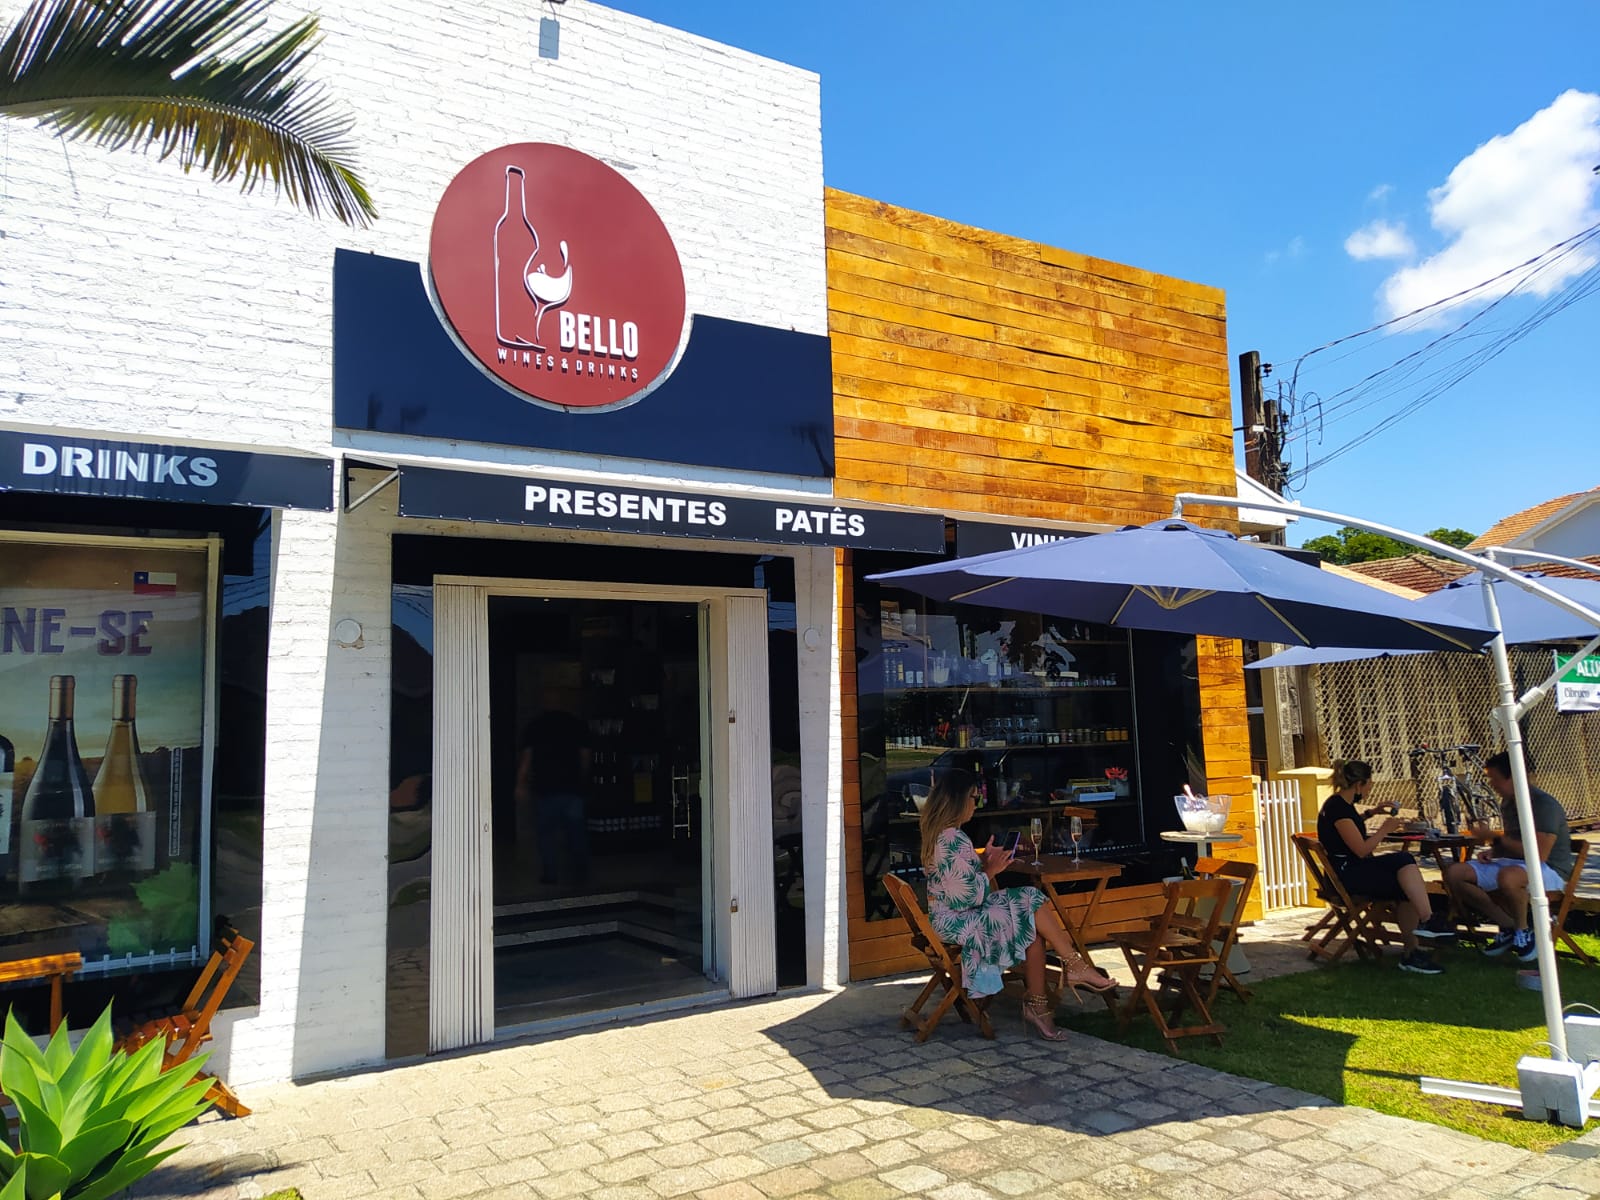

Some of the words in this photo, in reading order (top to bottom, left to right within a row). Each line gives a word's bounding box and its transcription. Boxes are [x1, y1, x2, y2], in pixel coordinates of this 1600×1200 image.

[560, 310, 639, 359] BELLO
[22, 443, 218, 487] DRINKS
[524, 484, 727, 526] PRESENTES
[775, 506, 865, 537] PATÊS
